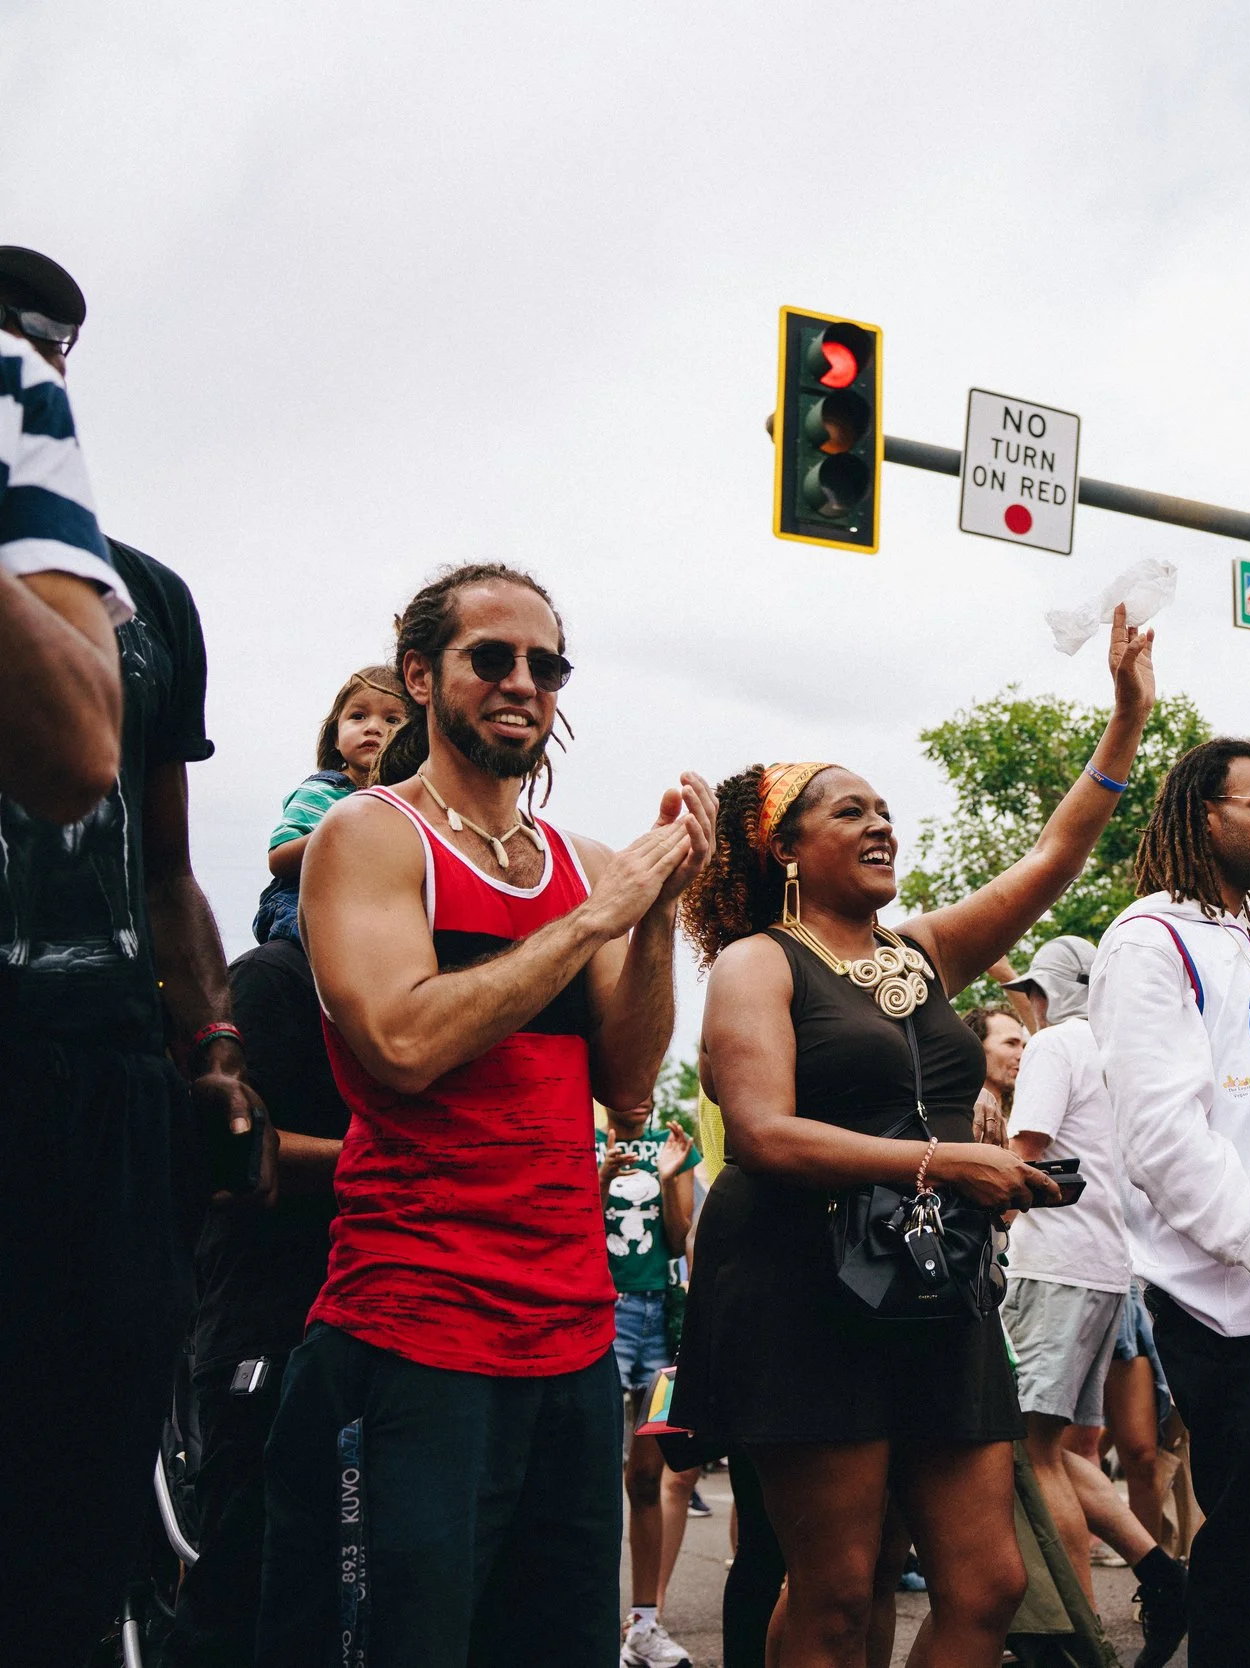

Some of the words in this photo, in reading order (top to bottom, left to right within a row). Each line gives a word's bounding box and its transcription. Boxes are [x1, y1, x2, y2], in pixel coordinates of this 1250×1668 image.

[1002, 406, 1047, 439] NO
[991, 437, 1056, 473] TURN
[972, 465, 1006, 492] ON
[1020, 477, 1067, 506] RED
[341, 1545, 358, 1583] 89.3
